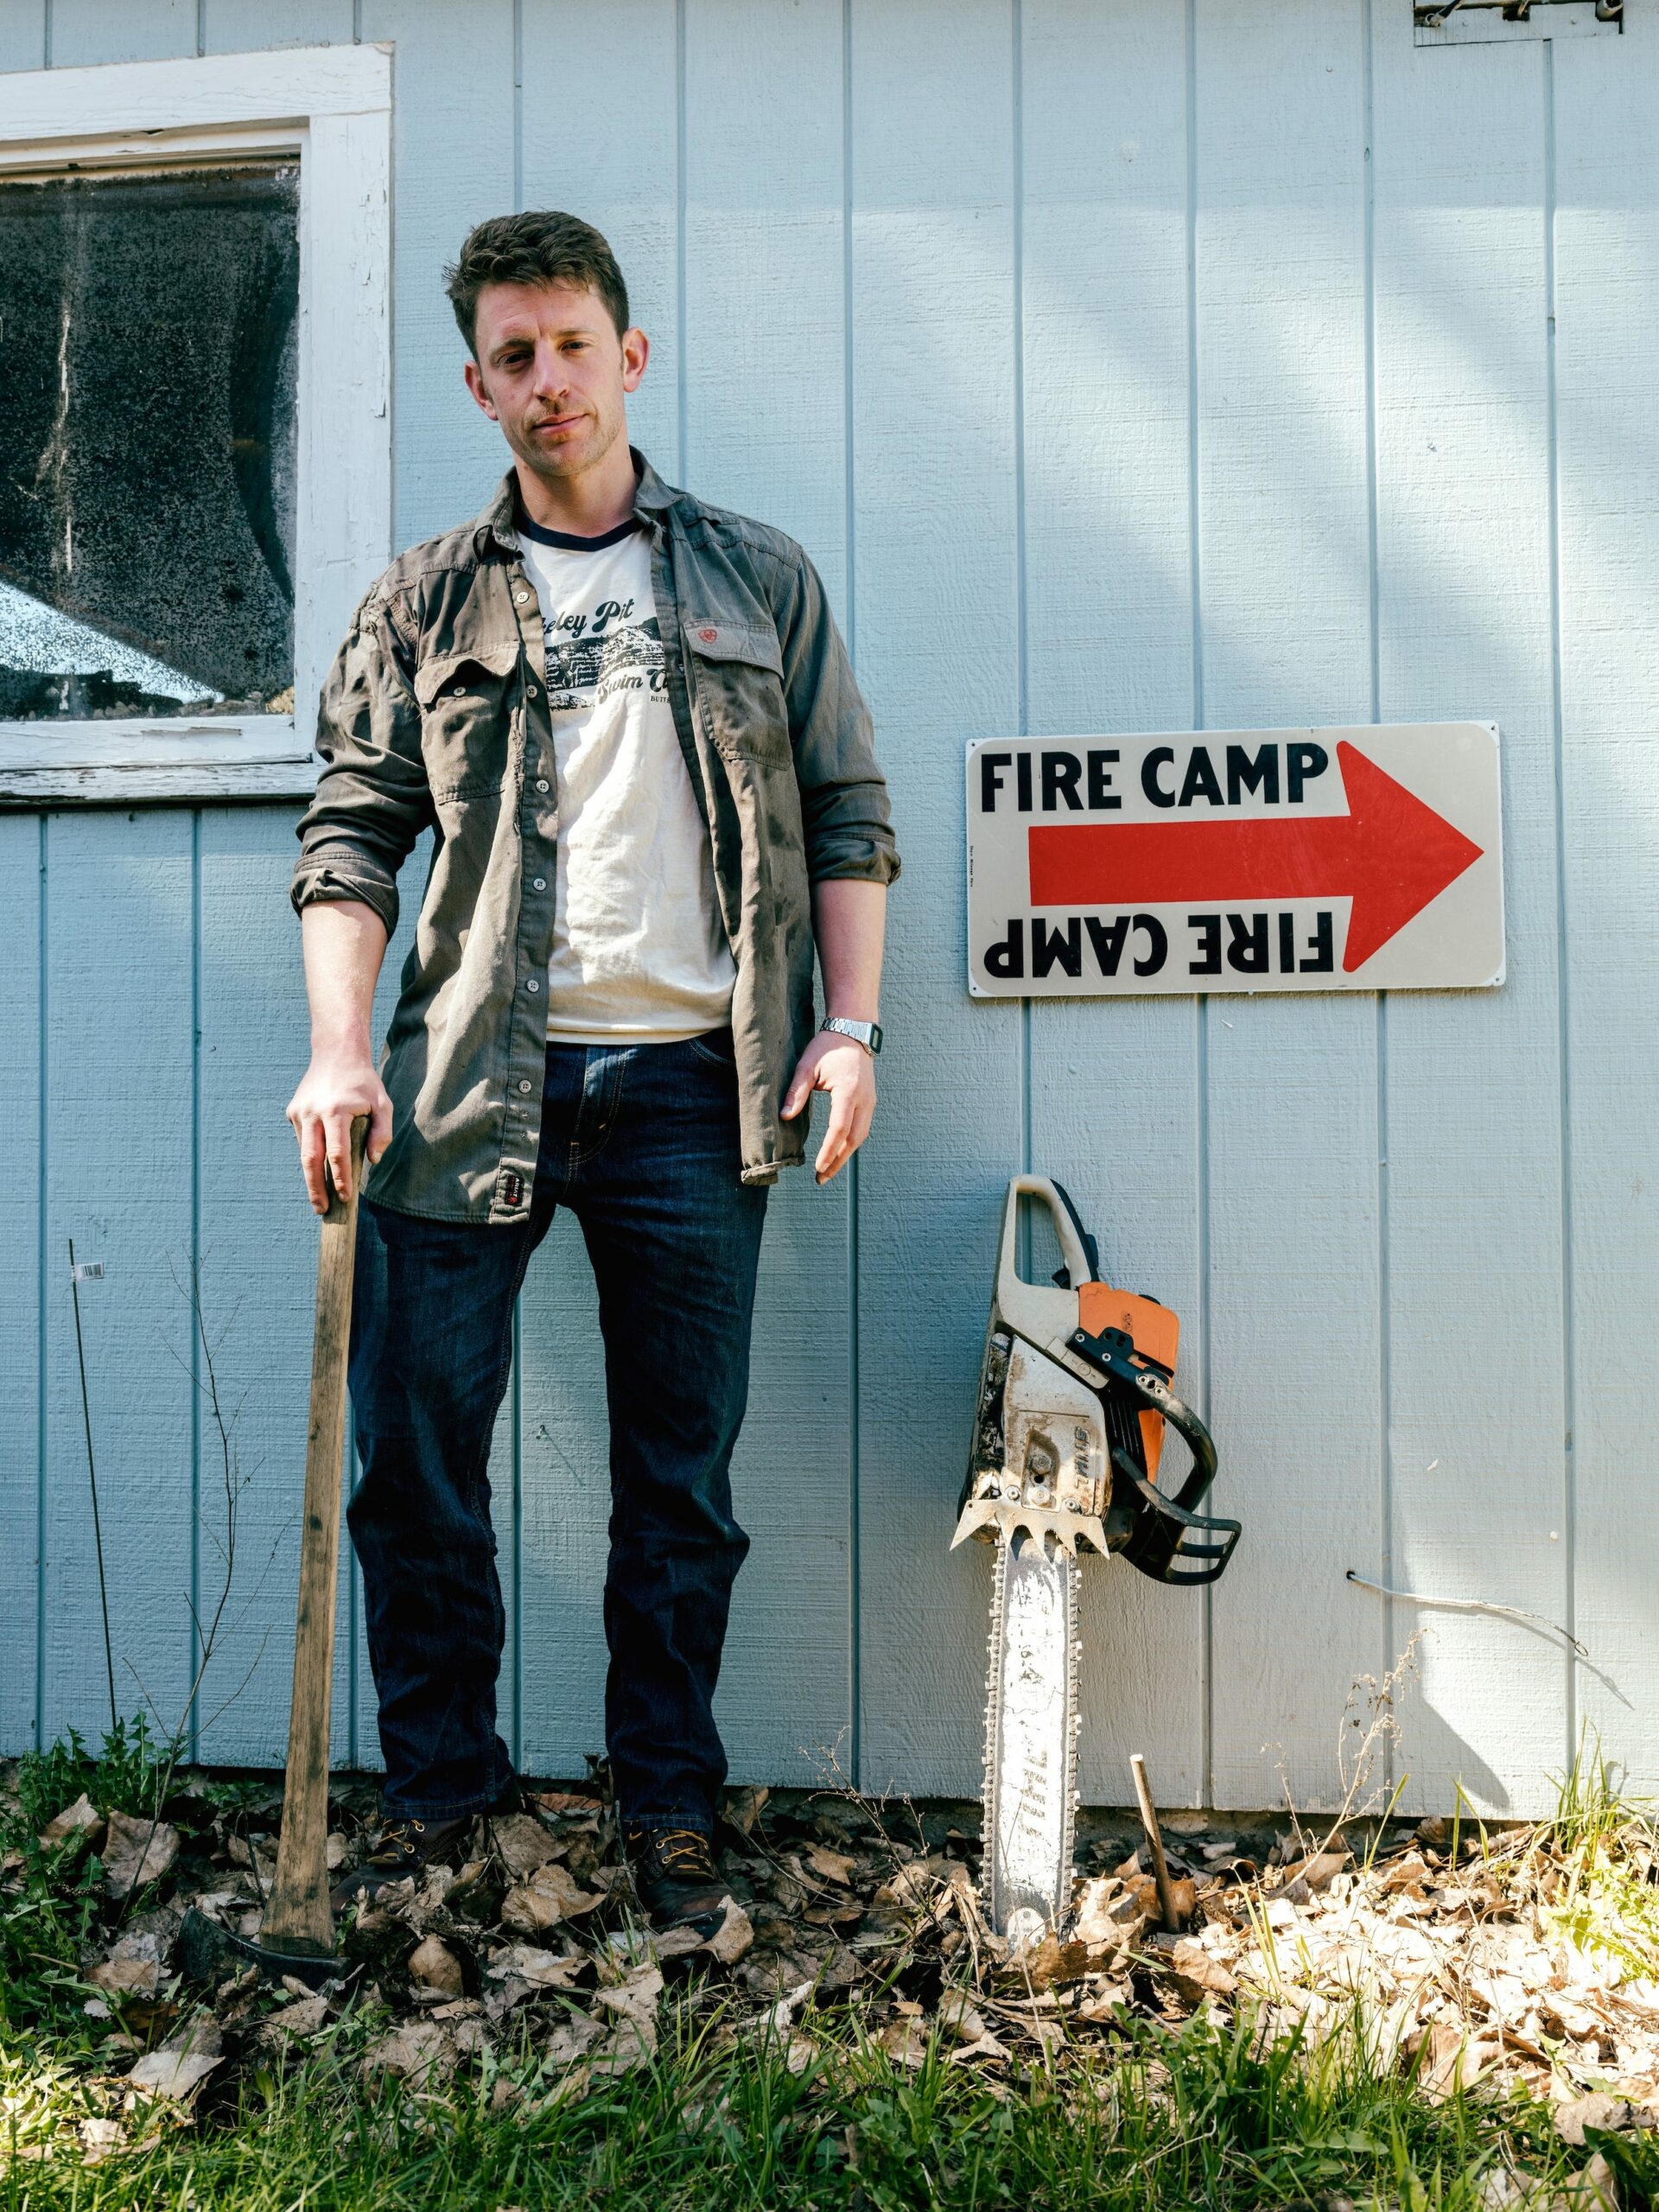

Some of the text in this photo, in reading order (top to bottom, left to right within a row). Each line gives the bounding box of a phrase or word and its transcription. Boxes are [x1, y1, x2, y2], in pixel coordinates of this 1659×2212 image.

[592, 598, 634, 632] Pit
[598, 674, 643, 704] Swim
[982, 742, 1329, 812] FIRE CAMP
[983, 912, 1334, 978] FIRE CAMP
[1074, 1426, 1090, 1489] STIHL
